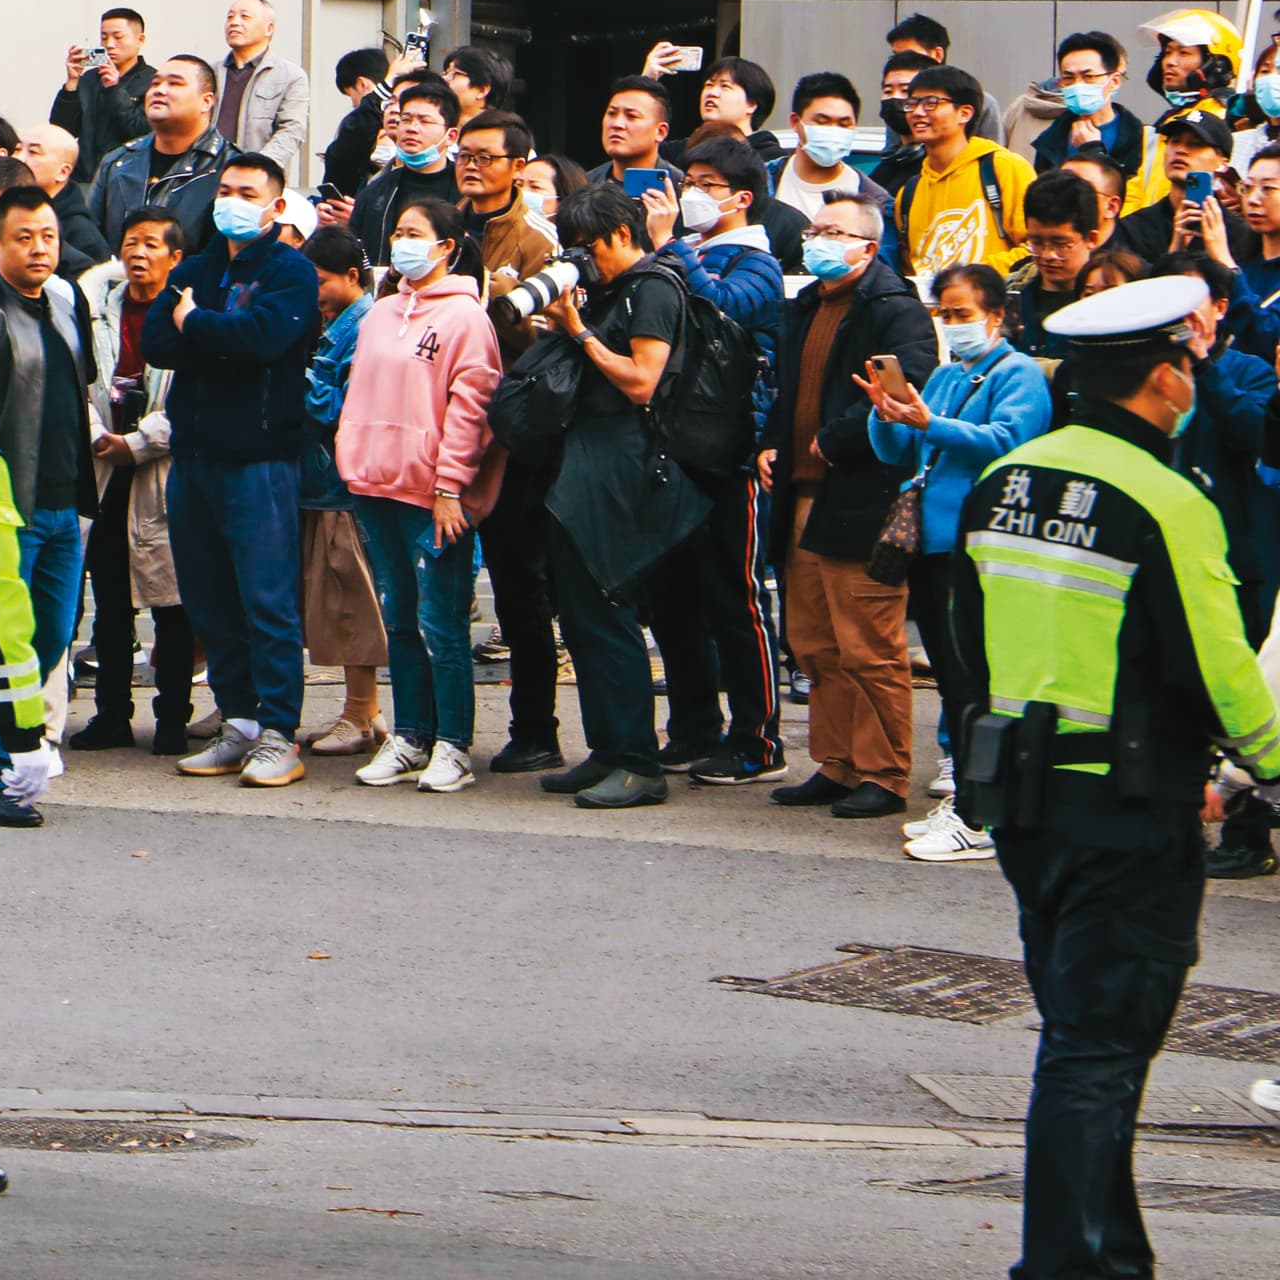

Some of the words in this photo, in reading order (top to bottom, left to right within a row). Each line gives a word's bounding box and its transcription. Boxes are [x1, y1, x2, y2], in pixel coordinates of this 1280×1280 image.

[1001, 469, 1099, 520] 执勤
[989, 507, 1037, 536] ZHI
[1043, 519, 1098, 549] QIN
